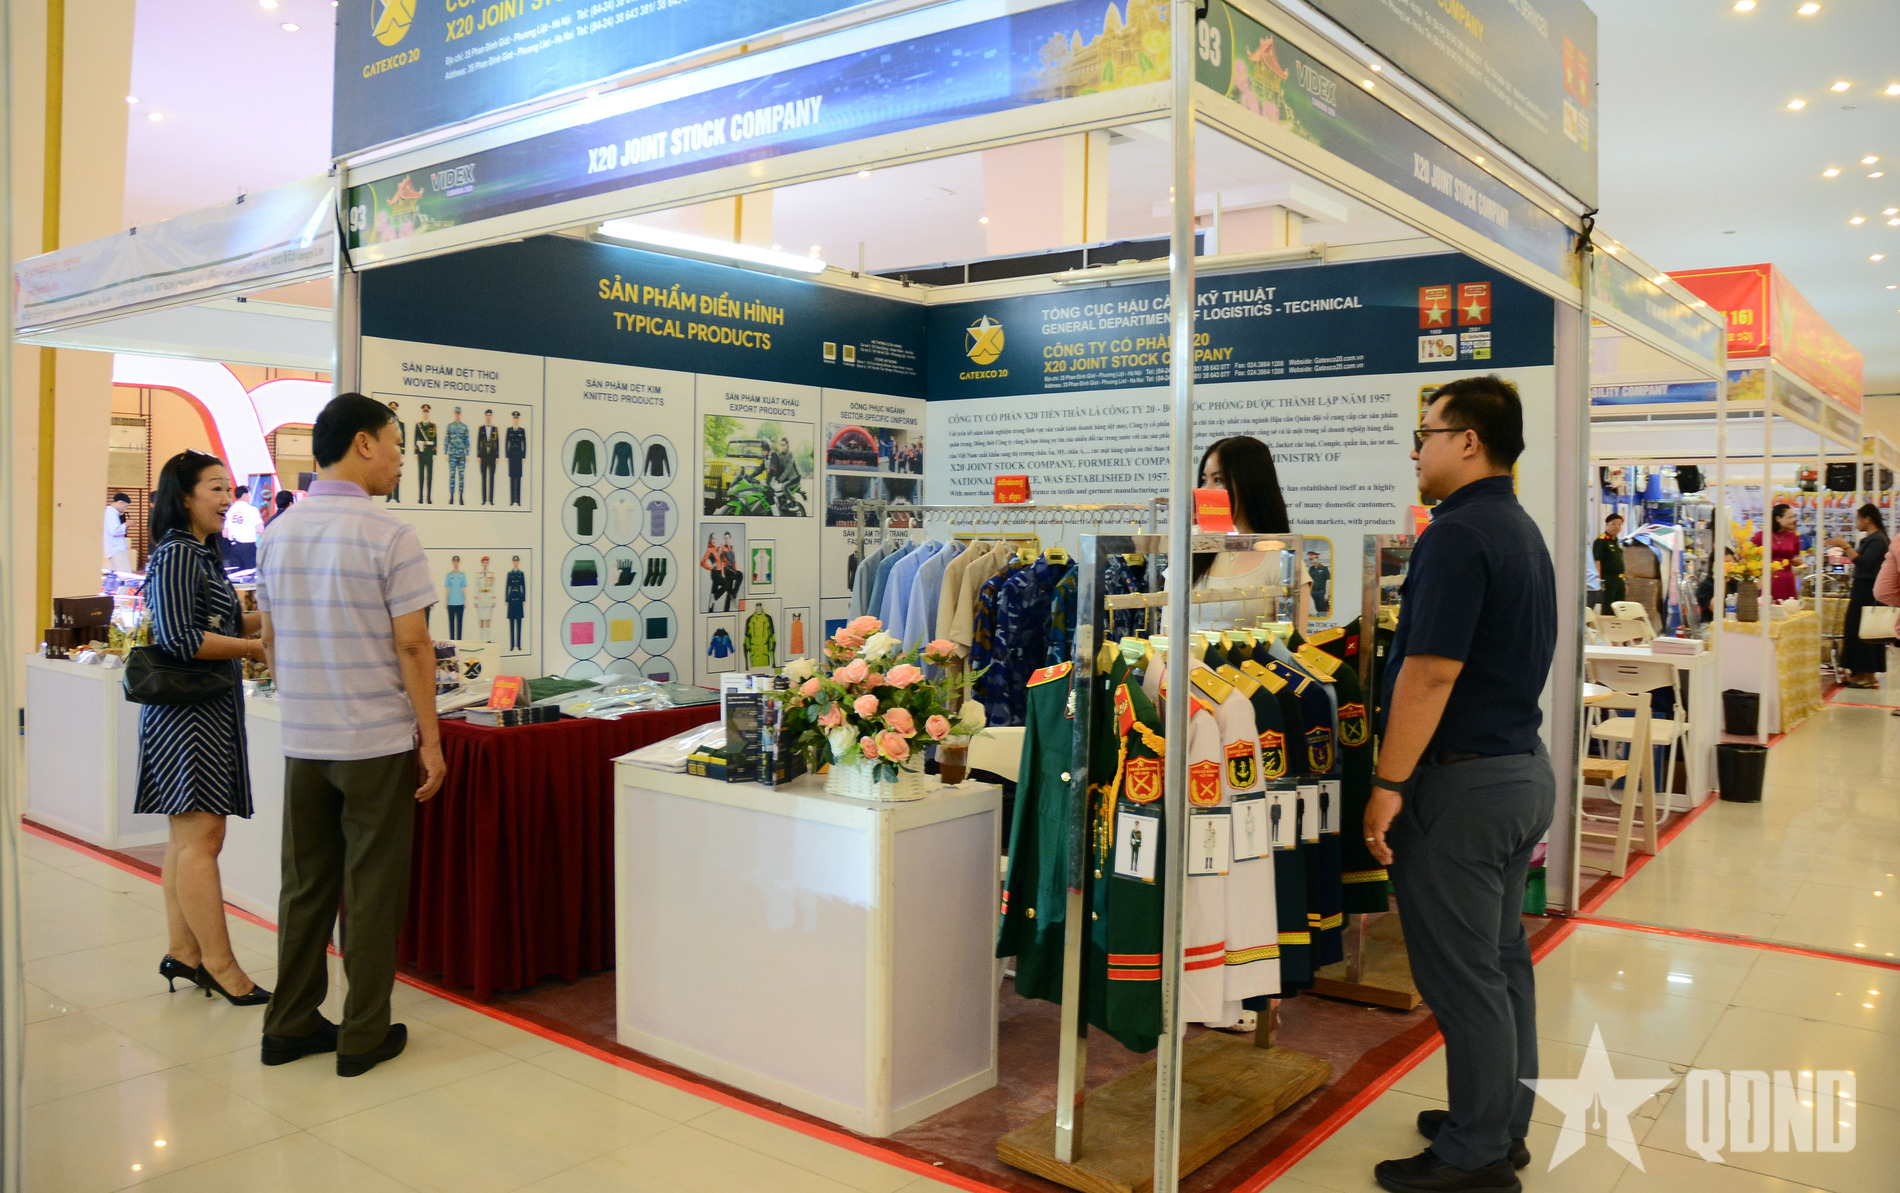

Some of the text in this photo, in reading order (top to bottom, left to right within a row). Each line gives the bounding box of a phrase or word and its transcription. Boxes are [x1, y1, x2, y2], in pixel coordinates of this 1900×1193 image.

[446, 14, 475, 42] X20
[576, 24, 589, 37] Tel:
[590, 15, 614, 35] (84-24)
[615, 12, 625, 24] 38
[625, 7, 639, 20] 643
[1198, 20, 1221, 67] 93
[363, 47, 421, 78] GATEXCO 20
[1296, 60, 1337, 107] VIDEX
[587, 95, 823, 174] X20 JOINT STOCK COMPANY
[430, 163, 476, 191] VIDEX
[1413, 152, 1509, 230] X20 JOINT STOCK COMPANY
[350, 205, 367, 232] 93
[599, 275, 784, 326] SẢN PHẨM ĐIỂN HÌNH
[1084, 302, 1114, 319] CỤC
[1197, 290, 1219, 307] KỸ
[1222, 287, 1276, 304] THUẬT
[1042, 319, 1097, 335] GENERAL
[1099, 313, 1171, 330] DEPARTMEN
[1203, 303, 1273, 321] LOGISTICS
[1283, 295, 1363, 314] TECHNICAL
[613, 311, 772, 351] TYPICAL PRODUCTS
[1043, 341, 1085, 358] CÔNG
[1088, 340, 1107, 355] TY
[402, 361, 422, 373] SẢN
[456, 368, 475, 380] DỆT
[478, 370, 499, 381] THOI
[1044, 359, 1067, 373] X20
[1069, 357, 1109, 371] JOINT
[1111, 352, 1158, 369] STOCK
[959, 369, 1009, 380] GATEXCO 20
[403, 377, 497, 394] WOVEN PRODUCTS
[647, 385, 661, 394] KIM
[1621, 384, 1669, 397] COMPANY
[583, 391, 664, 406] KNITTED PRODUCTS
[948, 413, 971, 424] CÔNG
[973, 414, 984, 423] TY
[1024, 411, 1038, 420] X20
[1089, 405, 1101, 416] LÀ
[1102, 404, 1129, 416] CÔNG
[1131, 405, 1143, 415] TY
[1146, 404, 1155, 413] 20
[1209, 399, 1244, 411] PHÒNG
[1246, 398, 1276, 410] ĐƯỢC
[1279, 395, 1315, 408] THÀNH
[1318, 396, 1339, 407] LẬP
[1341, 393, 1366, 405] NĂM
[1369, 393, 1391, 404] 1957
[729, 403, 795, 417] EXPORT PRODUCTS
[840, 410, 918, 426] SECTOR-SPECIFIC UNIFORMS
[950, 463, 965, 472] X20
[966, 462, 993, 472] JOINT
[994, 461, 1025, 471] STOCK
[1027, 459, 1076, 469] COMPANY,
[1078, 457, 1132, 468] FORMERLY
[1324, 452, 1341, 462] OF
[950, 476, 994, 486] NATIONAL
[1043, 474, 1063, 484] WAS
[1065, 473, 1132, 483] ESTABLISHED
[1134, 472, 1145, 482] IN
[1147, 472, 1170, 482] 1957.
[1114, 486, 1158, 494] manufacturing
[1287, 484, 1299, 492] has
[1300, 484, 1338, 492] established
[1339, 483, 1357, 491] itself
[1373, 483, 1396, 493] highly
[1304, 502, 1323, 510] many
[1357, 501, 1396, 509] customers,
[231, 514, 244, 525] 5G
[1316, 518, 1346, 526] markets,
[1347, 517, 1363, 525] with
[1364, 517, 1396, 526] products
[889, 530, 909, 538] TRANG
